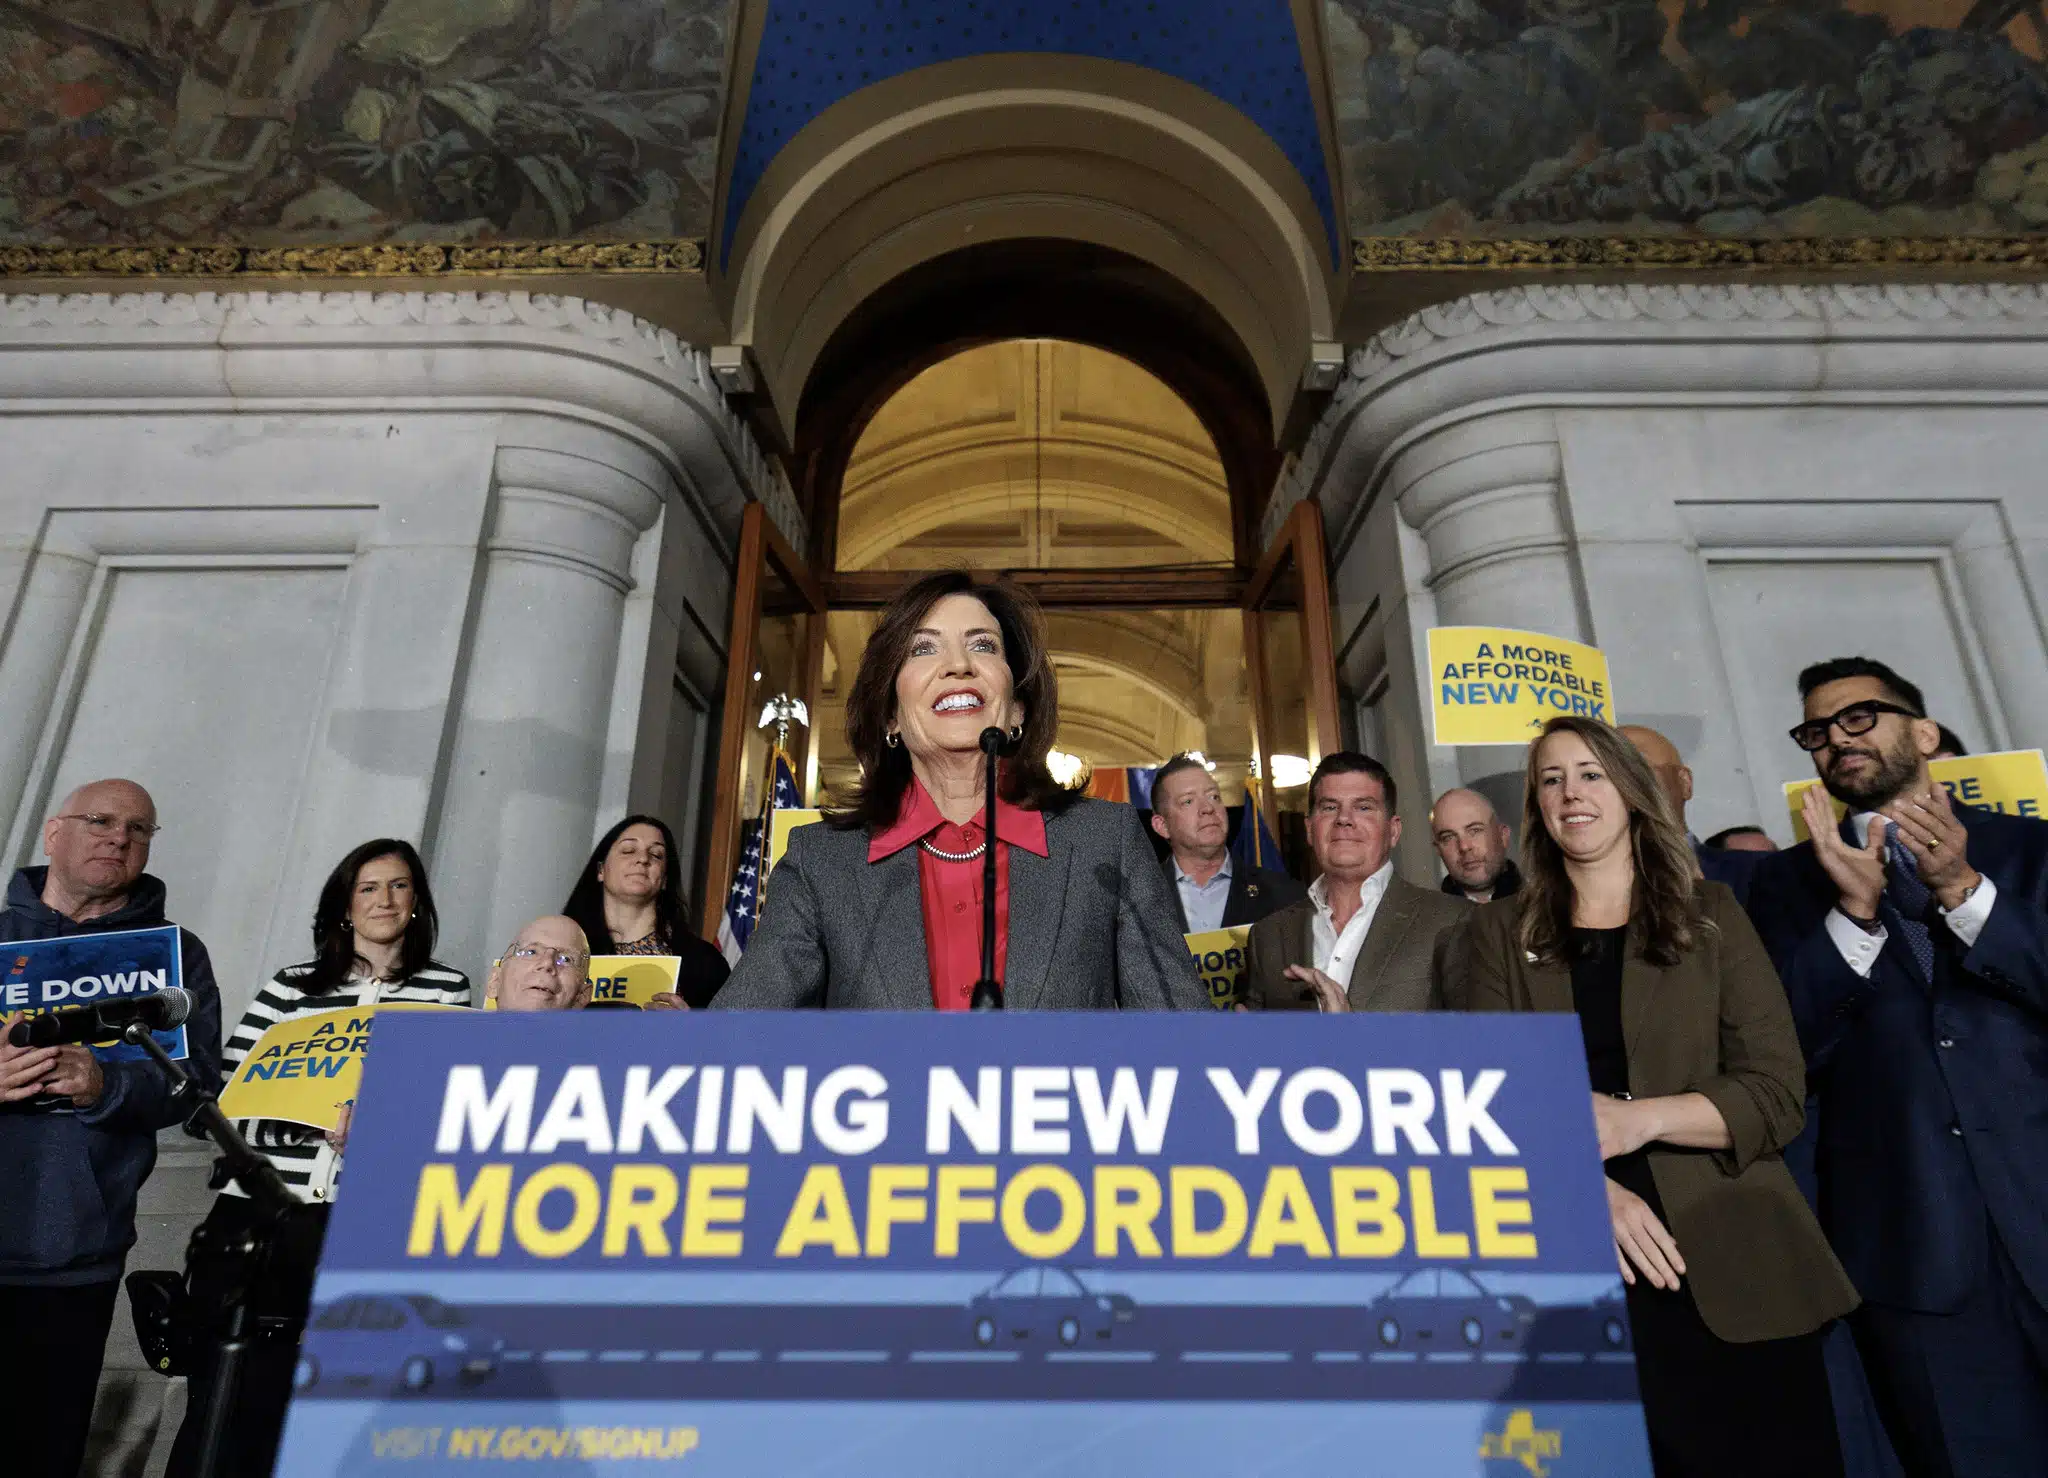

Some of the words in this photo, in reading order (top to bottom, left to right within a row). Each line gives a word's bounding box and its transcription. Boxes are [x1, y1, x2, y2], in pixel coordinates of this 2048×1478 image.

[1476, 643, 1494, 659] A
[1502, 644, 1573, 670] MORE
[1442, 663, 1604, 699] AFFORDABLE
[1442, 683, 1520, 706] NEW
[1528, 684, 1607, 722] YORK
[1940, 777, 1982, 800] RE
[42, 968, 167, 1002] DOWN
[586, 977, 628, 999] RE
[312, 1021, 336, 1037] A
[257, 1036, 369, 1061] AFFOR
[242, 1055, 350, 1084] NEW
[435, 1065, 890, 1155] MAKING
[925, 1066, 1180, 1155] NEW
[1206, 1066, 1521, 1156] YORK
[406, 1163, 751, 1259] MORE
[774, 1163, 1539, 1259] AFFORDABLE
